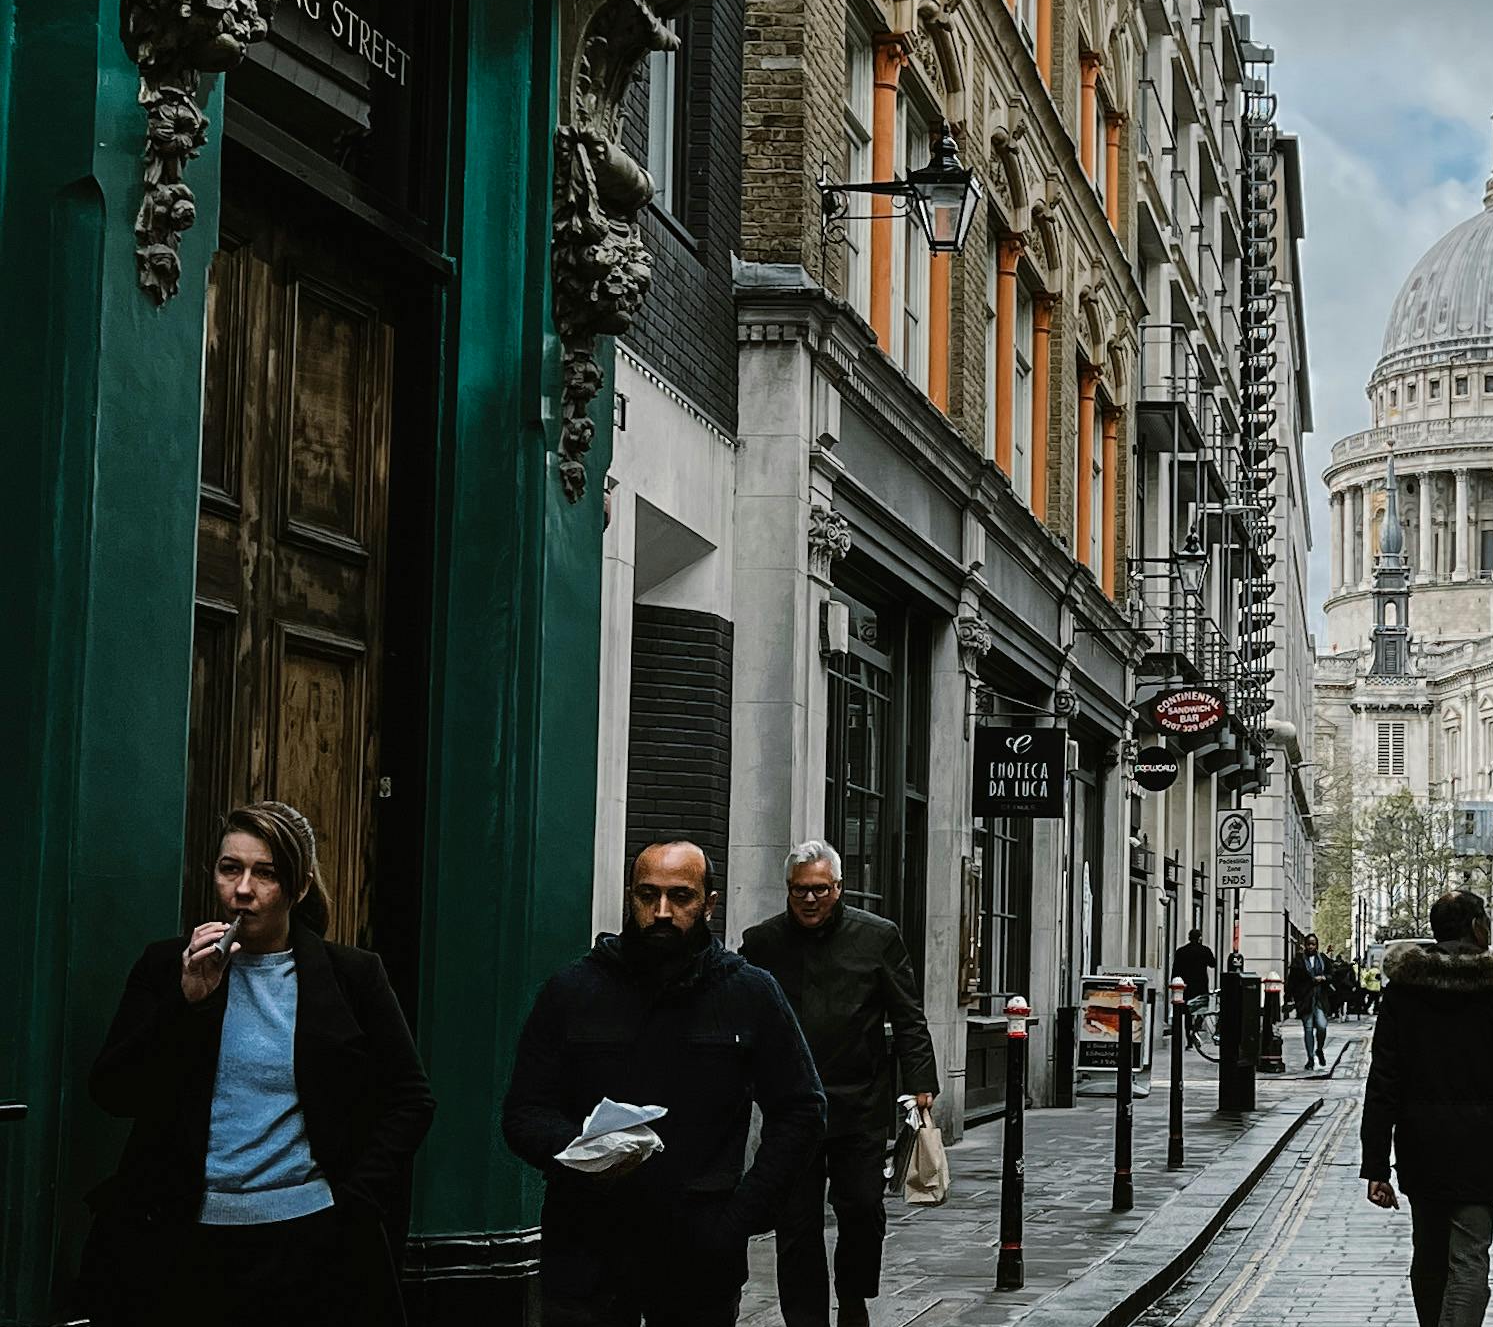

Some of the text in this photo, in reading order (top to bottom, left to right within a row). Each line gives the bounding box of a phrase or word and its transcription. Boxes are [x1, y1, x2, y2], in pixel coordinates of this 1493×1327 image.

[331, 0, 411, 86] STREET
[1157, 691, 1221, 713] CONTINENTAL
[1167, 704, 1212, 715] SANDWICH
[1179, 713, 1200, 724] BAR
[988, 779, 1048, 798] DA LUCA
[1222, 875, 1247, 885] ENDS
